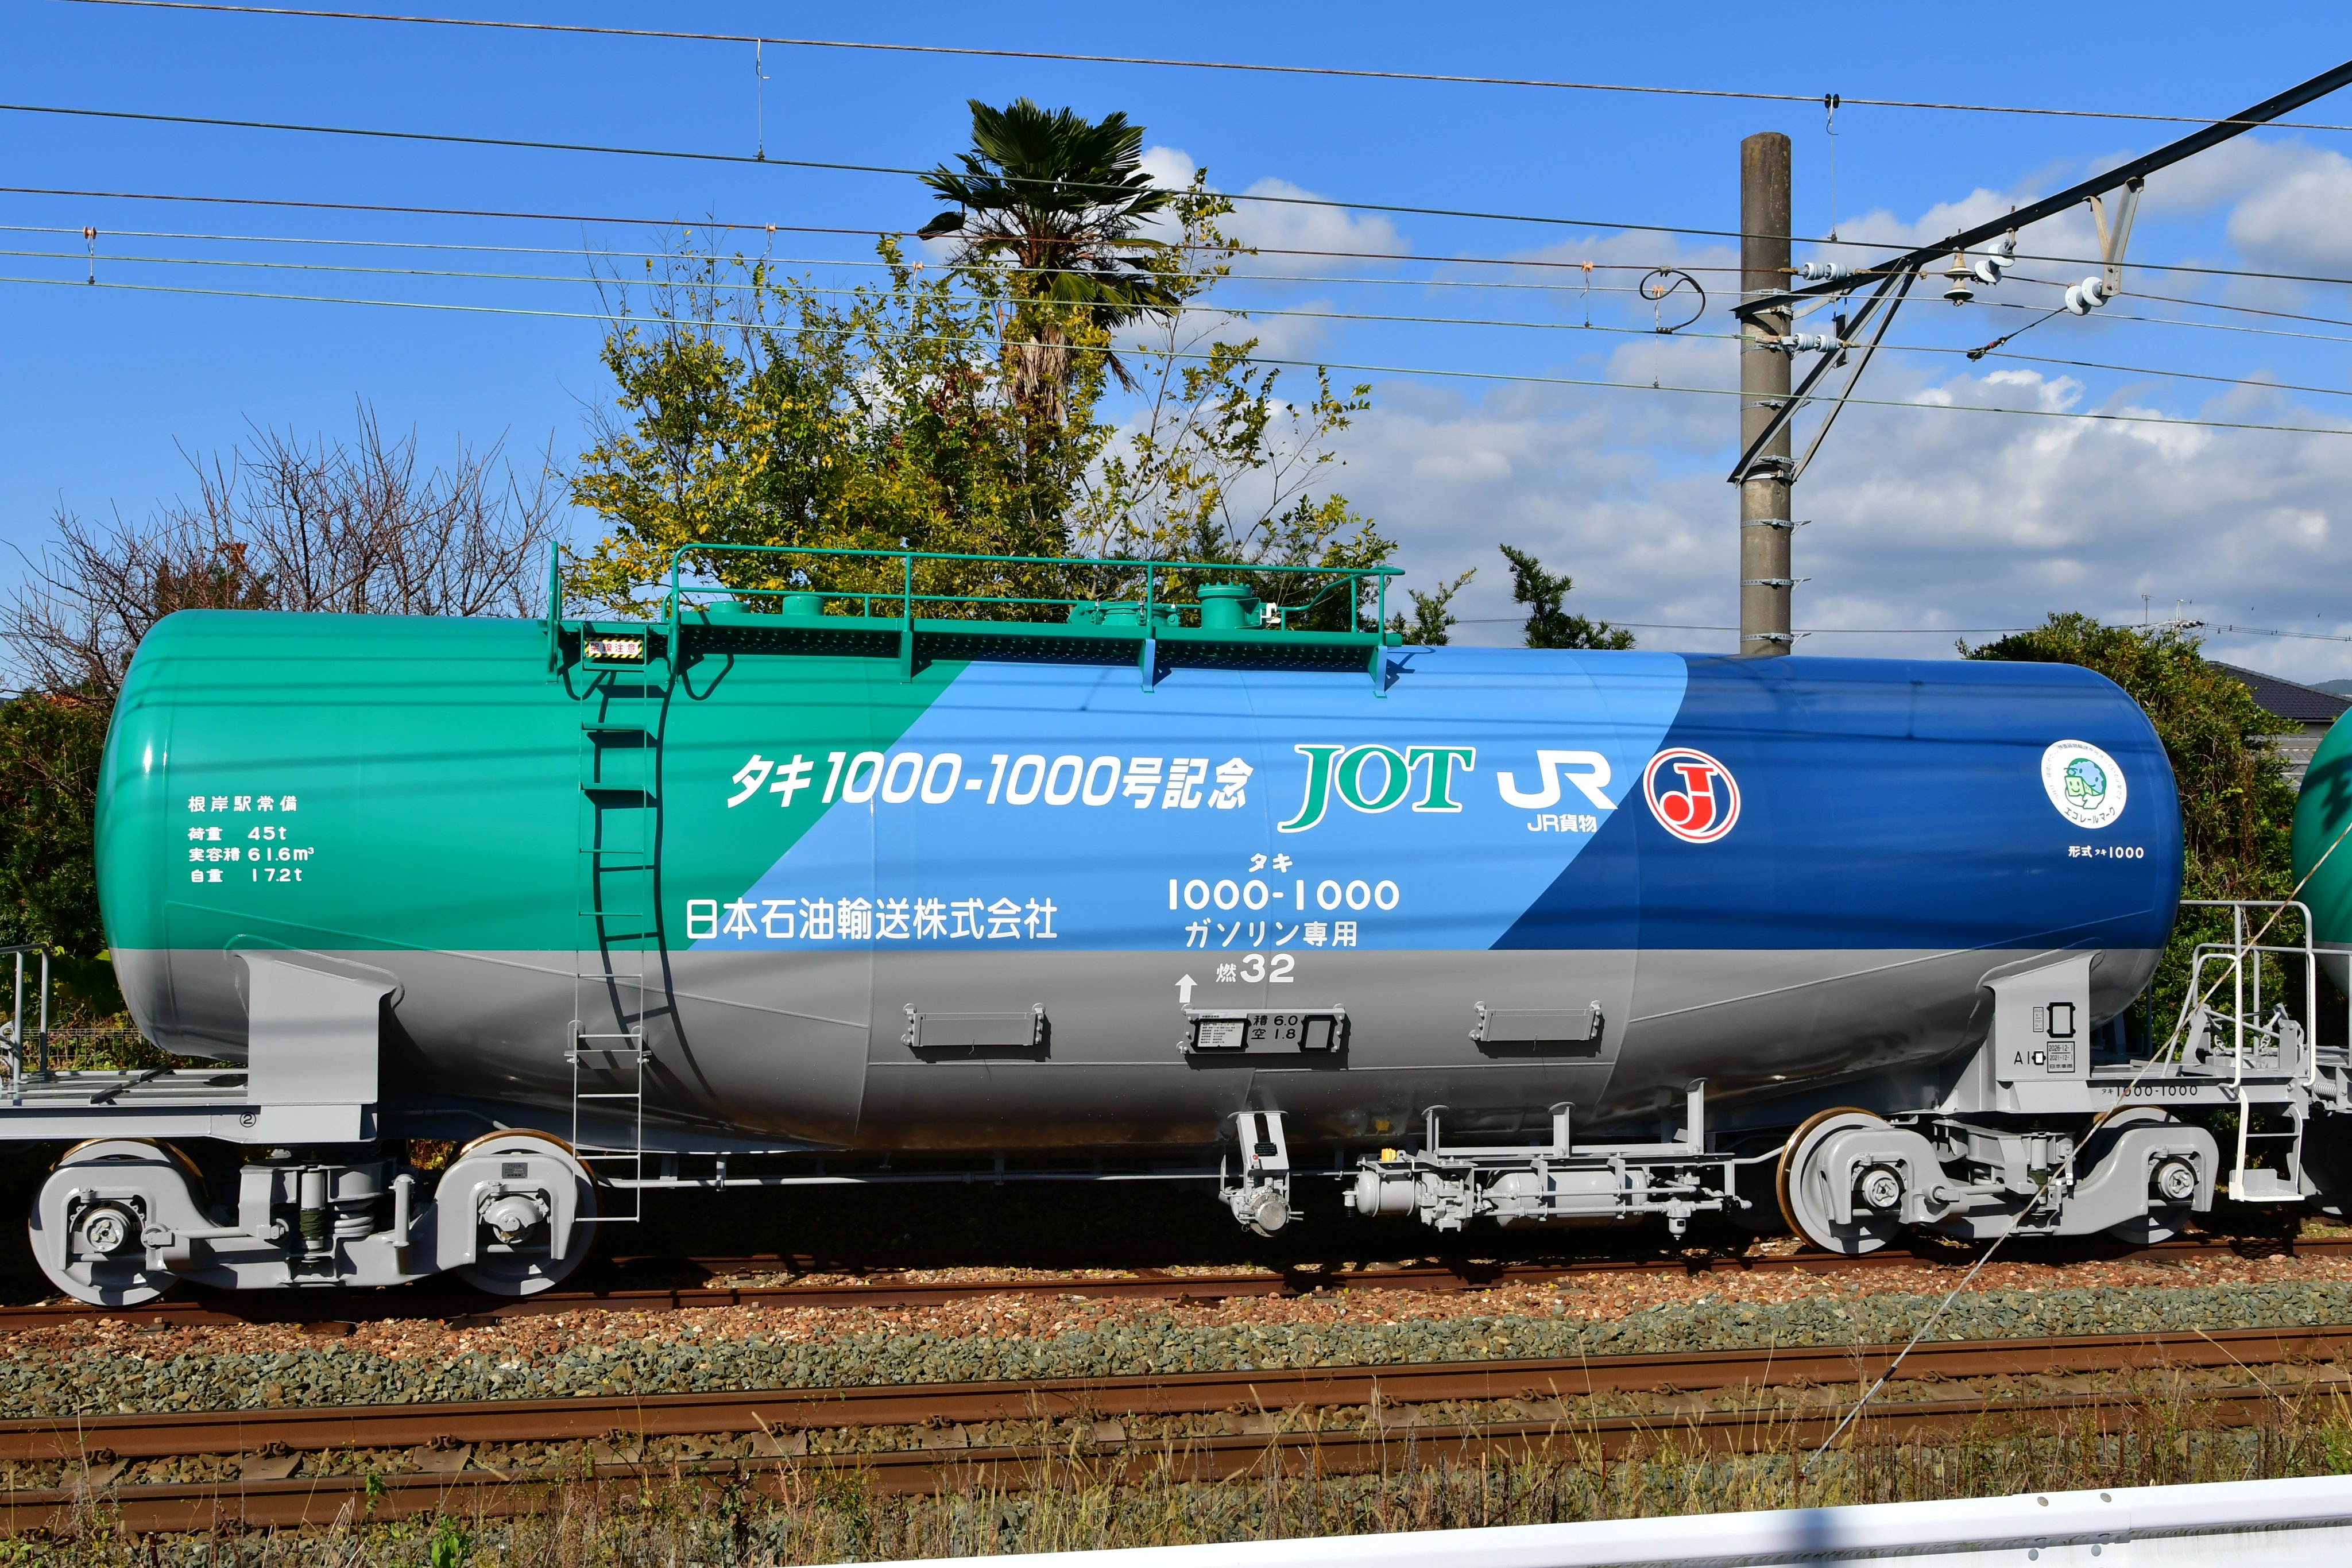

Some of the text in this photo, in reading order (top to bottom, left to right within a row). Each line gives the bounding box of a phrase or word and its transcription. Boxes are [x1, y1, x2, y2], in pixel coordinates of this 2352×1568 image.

[590, 642, 636, 653] 架線注意
[1277, 744, 1476, 833] JOT
[1497, 750, 1618, 810] JR
[188, 795, 297, 812] 根岸駅常備
[1527, 814, 1597, 833] JR貨物
[2064, 807, 2115, 824] エコレールマーク
[188, 826, 287, 841] 荷重 45t
[189, 847, 240, 862] 実容積
[2068, 845, 2092, 858] 形式
[1248, 853, 1293, 873] タキ
[191, 868, 302, 882] 自重 17.2t
[1169, 879, 1399, 910] 1000-1000
[687, 897, 1057, 939] 日本石油輸送株式会社
[1185, 917, 1357, 948] ガソリン専用
[1253, 1015, 1298, 1026] 積 6.0
[1251, 1028, 1296, 1040] 空 1.8
